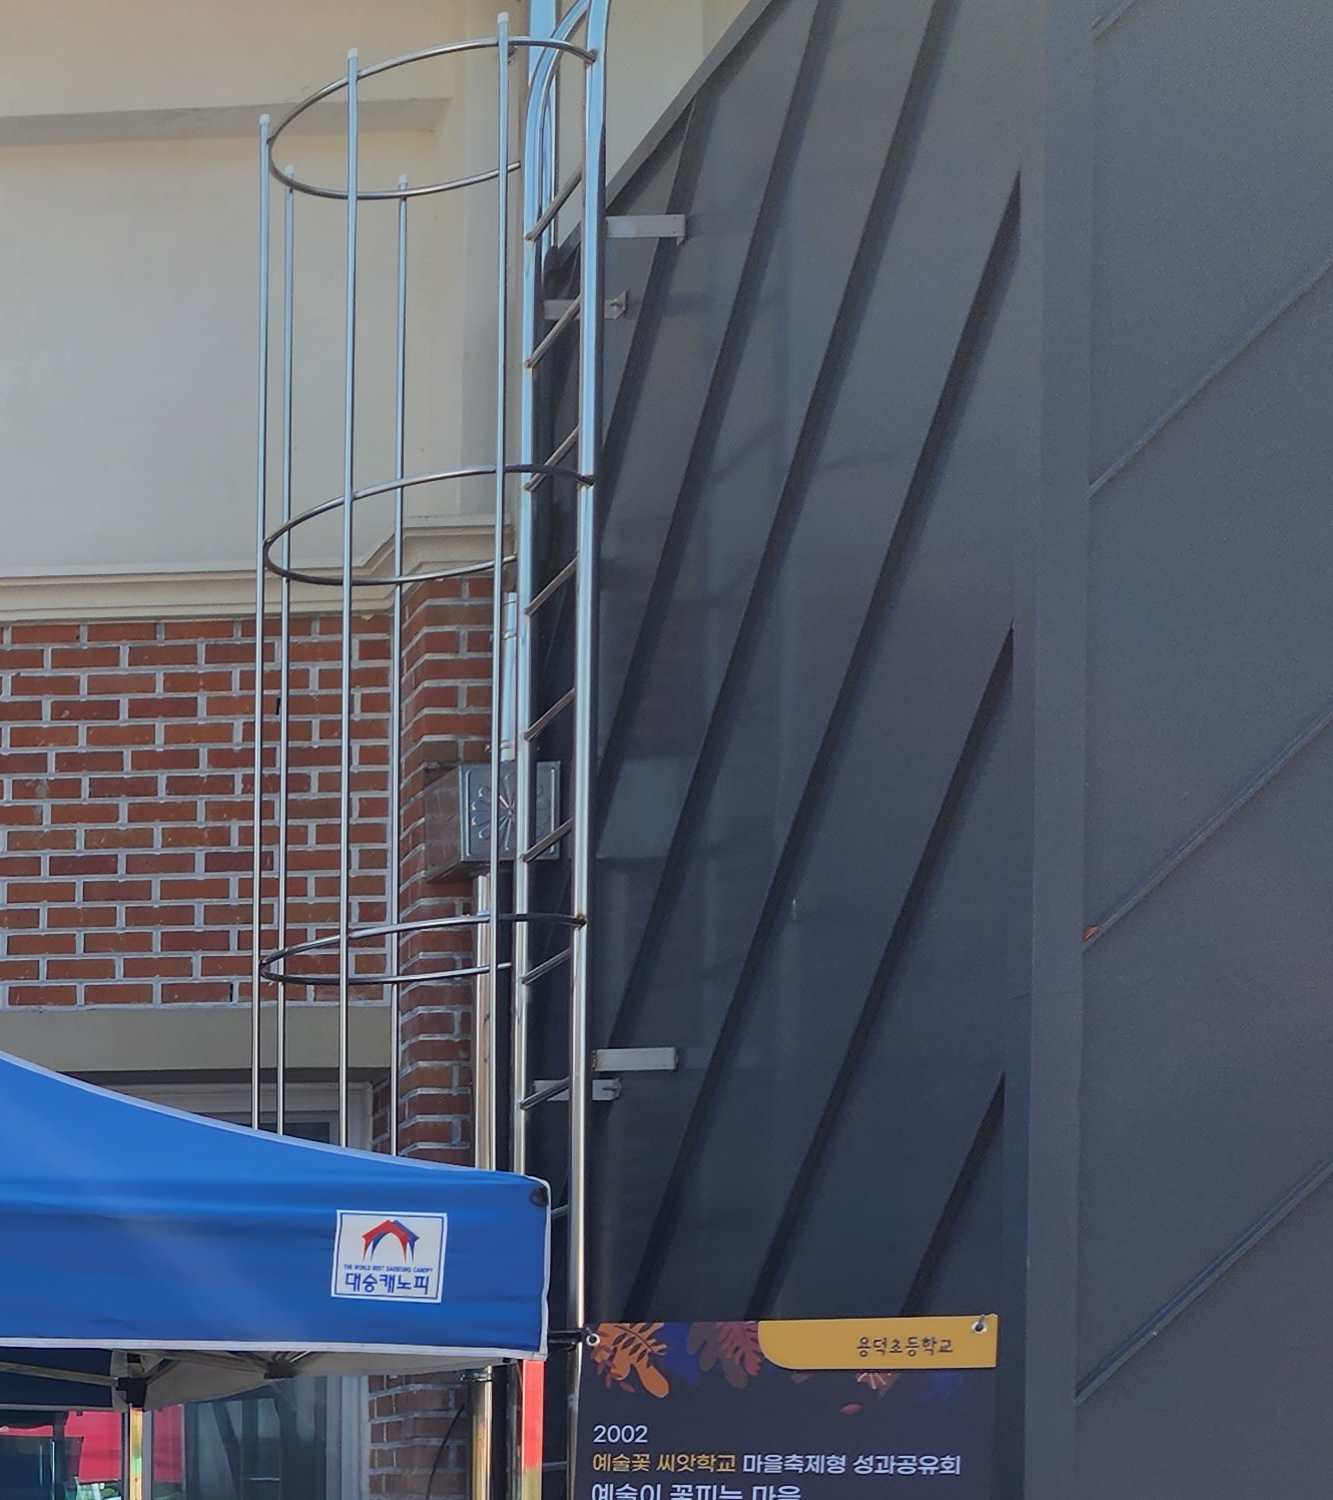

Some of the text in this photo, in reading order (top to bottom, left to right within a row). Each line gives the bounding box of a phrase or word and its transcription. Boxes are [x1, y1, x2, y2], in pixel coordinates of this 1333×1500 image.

[345, 1273, 429, 1295] 대승캐노피
[857, 1336, 954, 1357] 용덕초등학교
[593, 1425, 648, 1444] 2002
[592, 1452, 961, 1476] 예술꽃 씨앗학교 마을축제형 성과공유회
